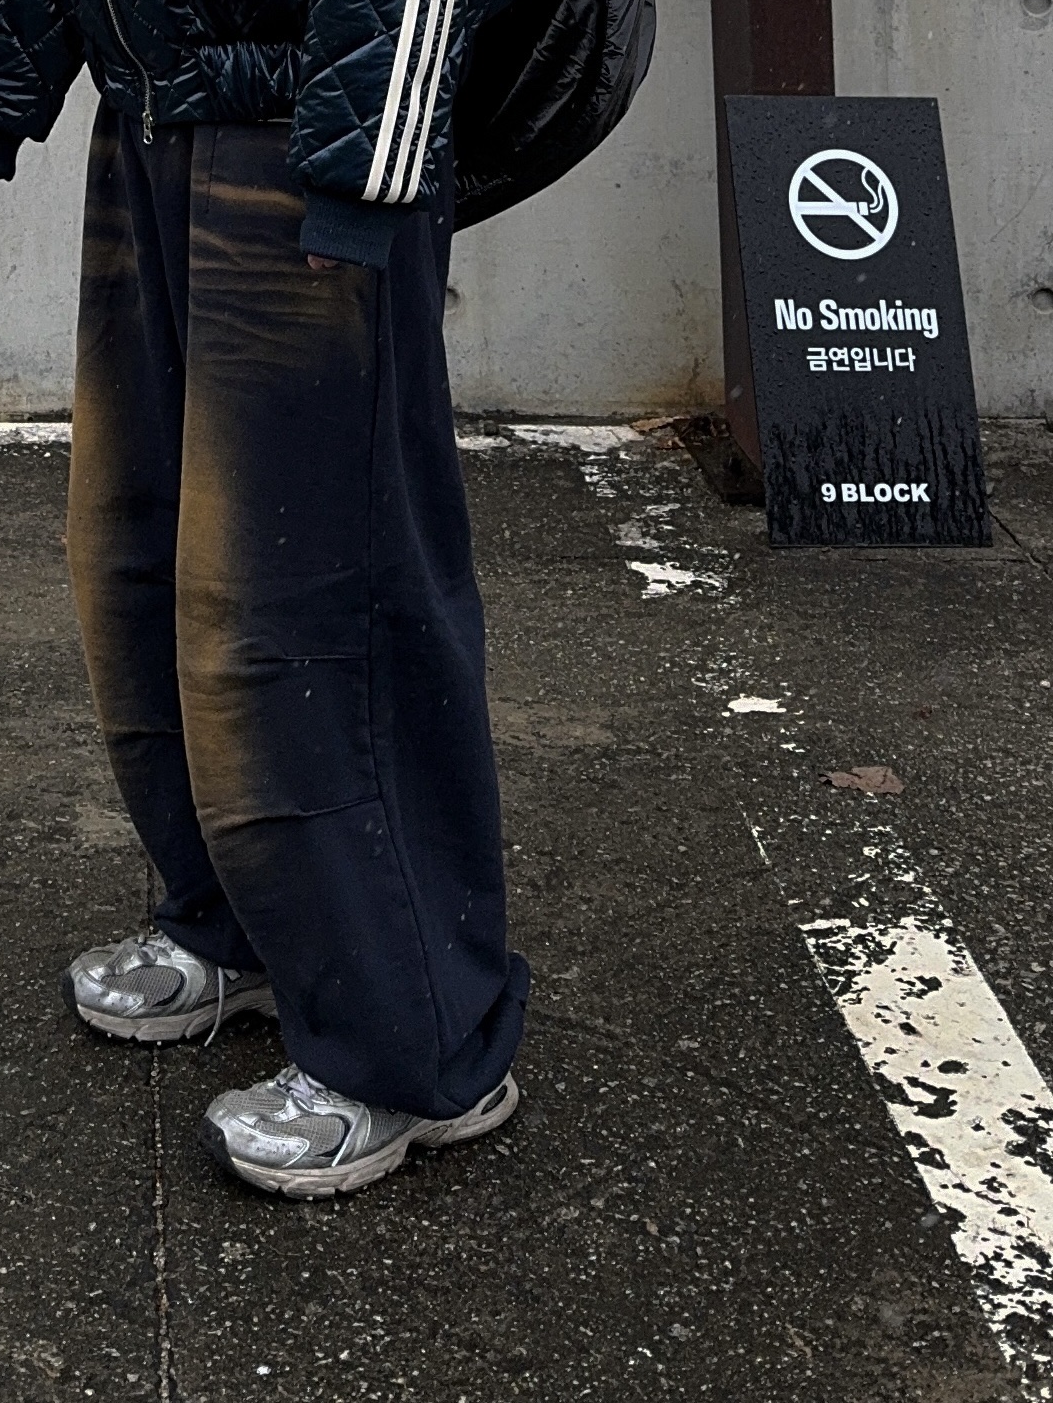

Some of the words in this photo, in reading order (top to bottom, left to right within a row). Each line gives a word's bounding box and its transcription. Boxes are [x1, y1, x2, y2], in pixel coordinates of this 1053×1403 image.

[774, 298, 813, 331] No
[818, 298, 939, 339] Smoking
[806, 346, 916, 372] 금연입니다
[821, 483, 837, 503] 9
[841, 483, 931, 503] BLOCK
